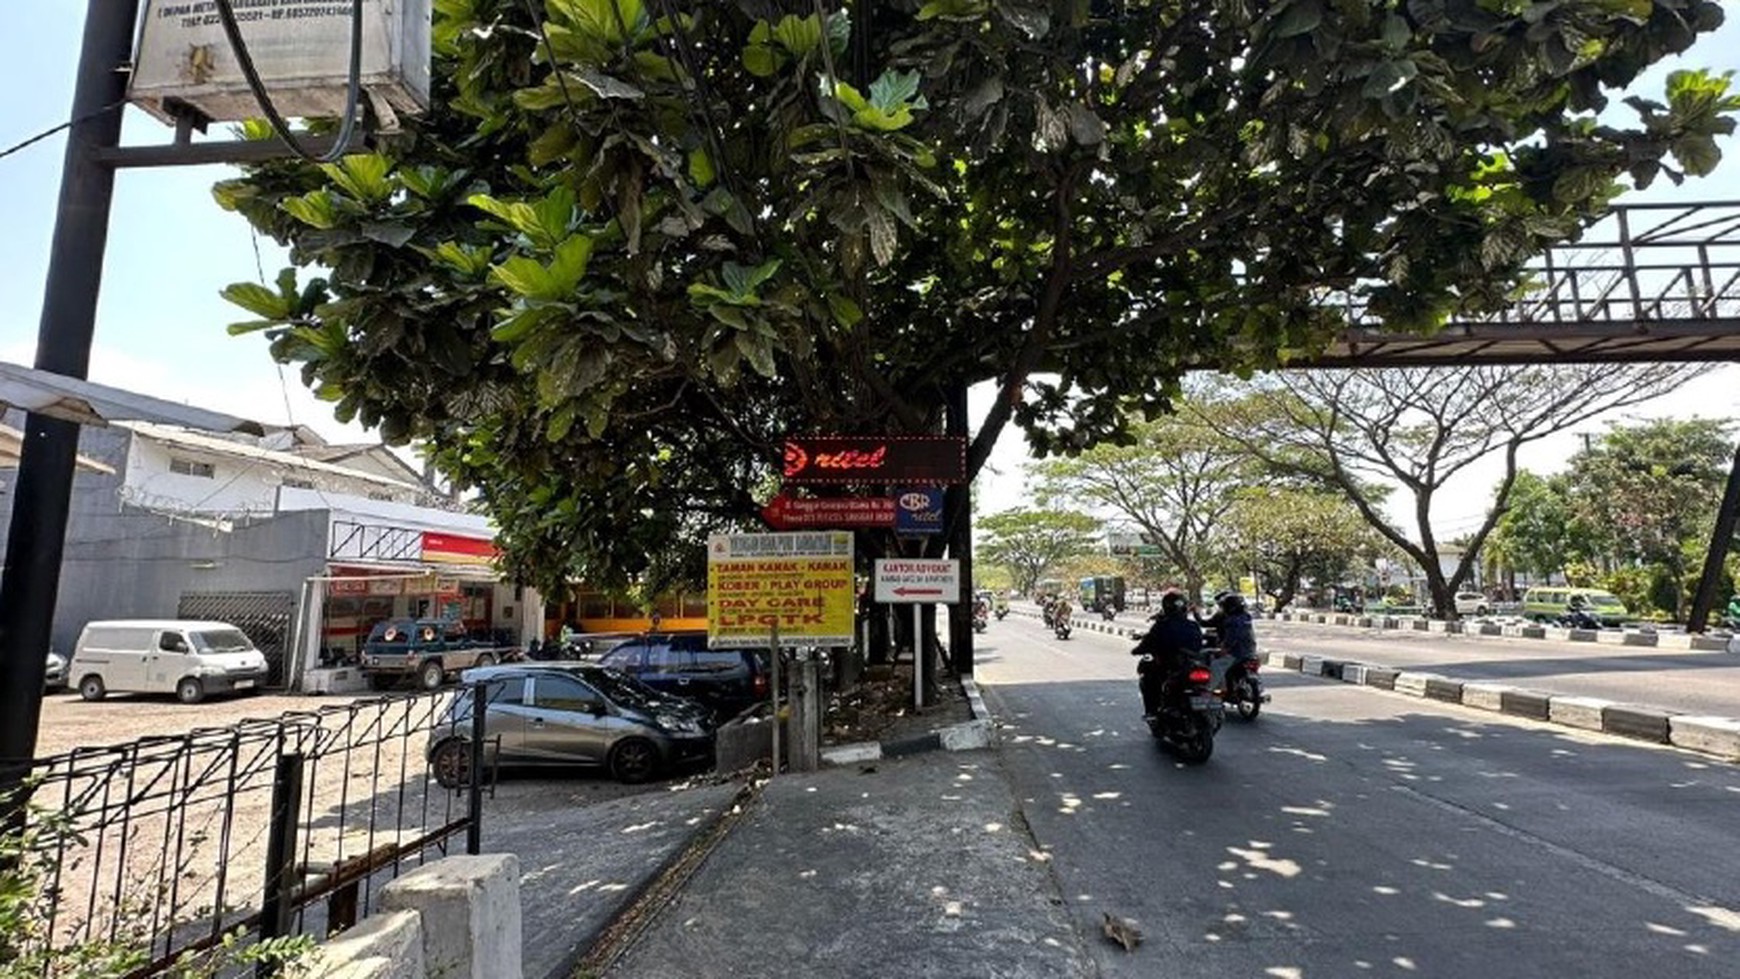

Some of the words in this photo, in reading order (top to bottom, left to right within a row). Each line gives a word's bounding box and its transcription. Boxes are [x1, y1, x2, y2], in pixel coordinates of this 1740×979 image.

[899, 492, 930, 511] CBR
[716, 563, 755, 573] TAMAN
[718, 581, 760, 591] KOBER
[770, 580, 800, 590] PLAY
[803, 579, 848, 589] GROUP
[719, 598, 759, 608] DAY
[767, 597, 826, 608] CARE
[719, 614, 825, 626] LPGTK
